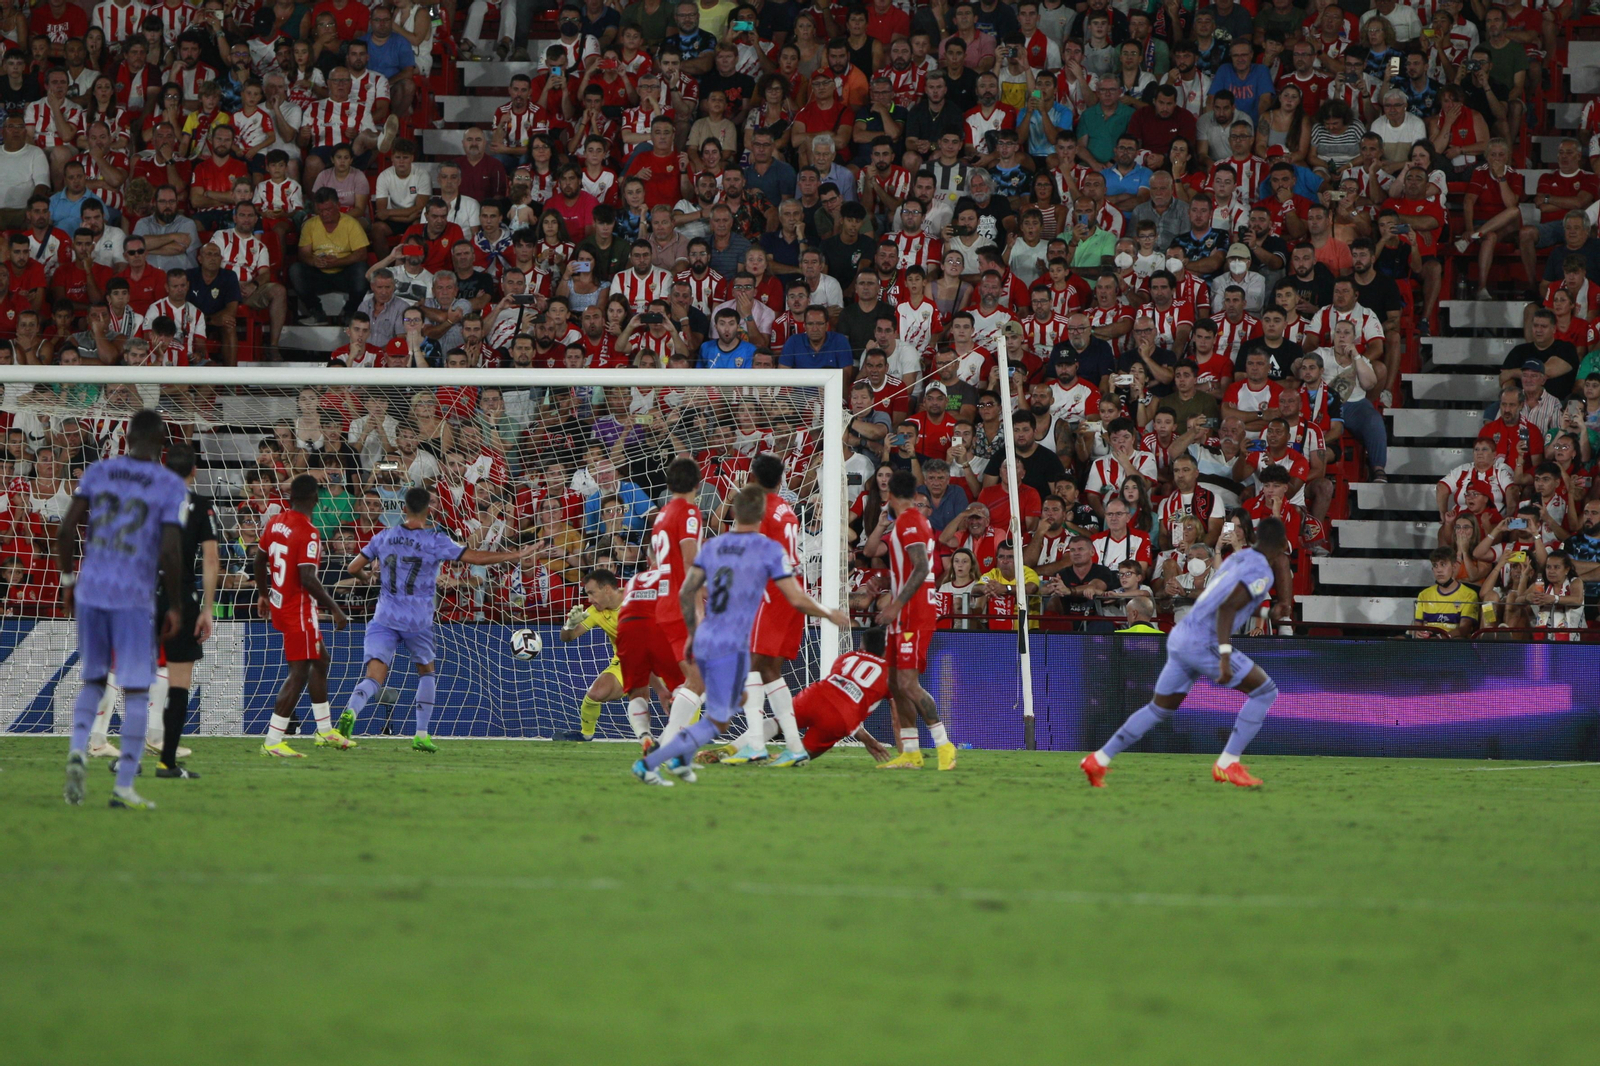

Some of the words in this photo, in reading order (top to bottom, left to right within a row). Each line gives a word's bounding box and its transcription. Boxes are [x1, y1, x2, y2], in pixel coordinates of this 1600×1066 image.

[91, 490, 149, 556] 22
[388, 536, 414, 547] LUCAS
[383, 553, 423, 596] 17
[710, 565, 735, 615] 8
[840, 655, 883, 689] 10
